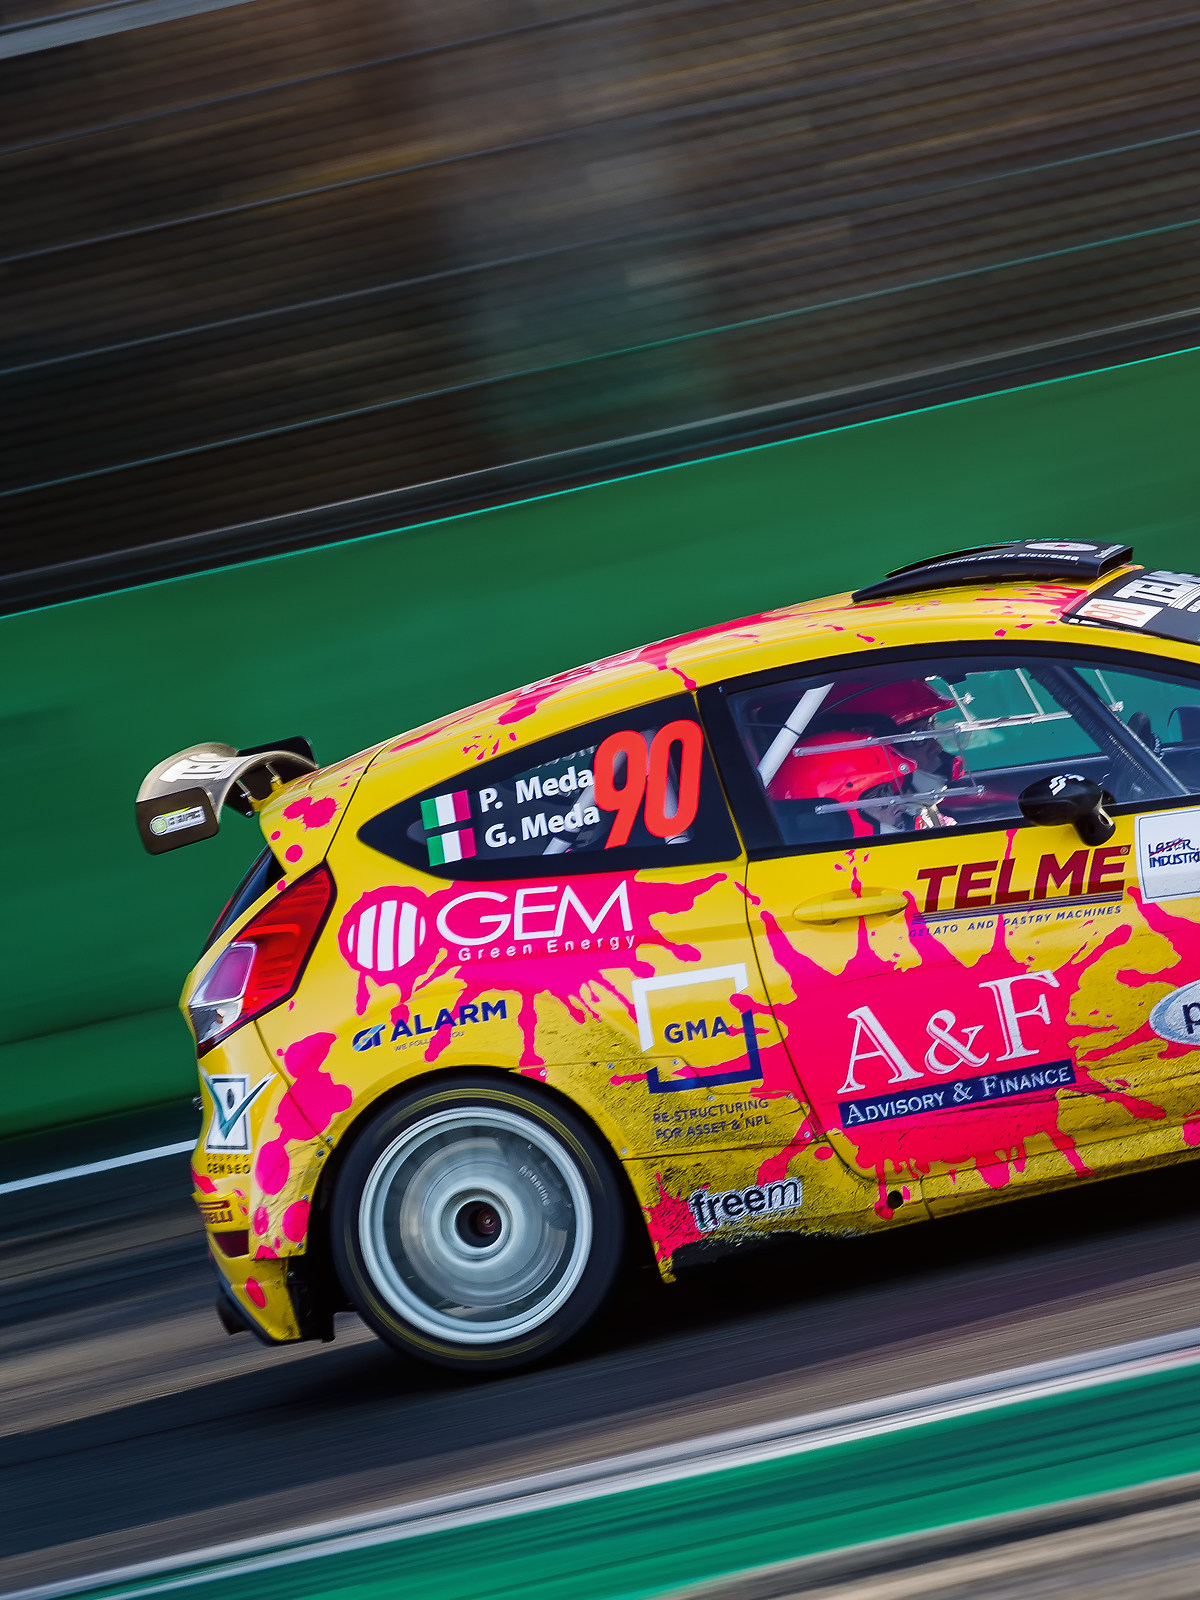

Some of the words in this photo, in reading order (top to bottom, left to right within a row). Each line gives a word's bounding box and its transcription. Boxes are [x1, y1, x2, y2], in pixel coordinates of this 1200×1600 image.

[479, 787, 504, 812] P.
[515, 766, 594, 804] Meda
[593, 719, 704, 850] 90
[485, 823, 516, 848] G.
[521, 803, 600, 841] Meda
[1148, 838, 1196, 855] LASER
[916, 844, 1132, 913] TELME
[436, 880, 634, 946] GEM
[909, 924, 959, 938] GELATO
[967, 919, 994, 931] AND
[1003, 913, 1051, 926] PASTRY
[1055, 905, 1122, 920] MACHINES
[458, 942, 533, 962] Green
[547, 934, 636, 953] Energy
[390, 999, 508, 1043] ALARM
[664, 1015, 731, 1044] GMA
[836, 969, 1061, 1095] A&F
[652, 1098, 770, 1125] RE-STRUCTURING
[845, 1091, 945, 1125] ADVISORY
[953, 1082, 973, 1103] &
[979, 1066, 1072, 1098] FINANCE
[655, 1127, 684, 1141] FOR
[686, 1121, 728, 1138] ASSET
[745, 1115, 772, 1129] NPL
[690, 1179, 801, 1225] freem
